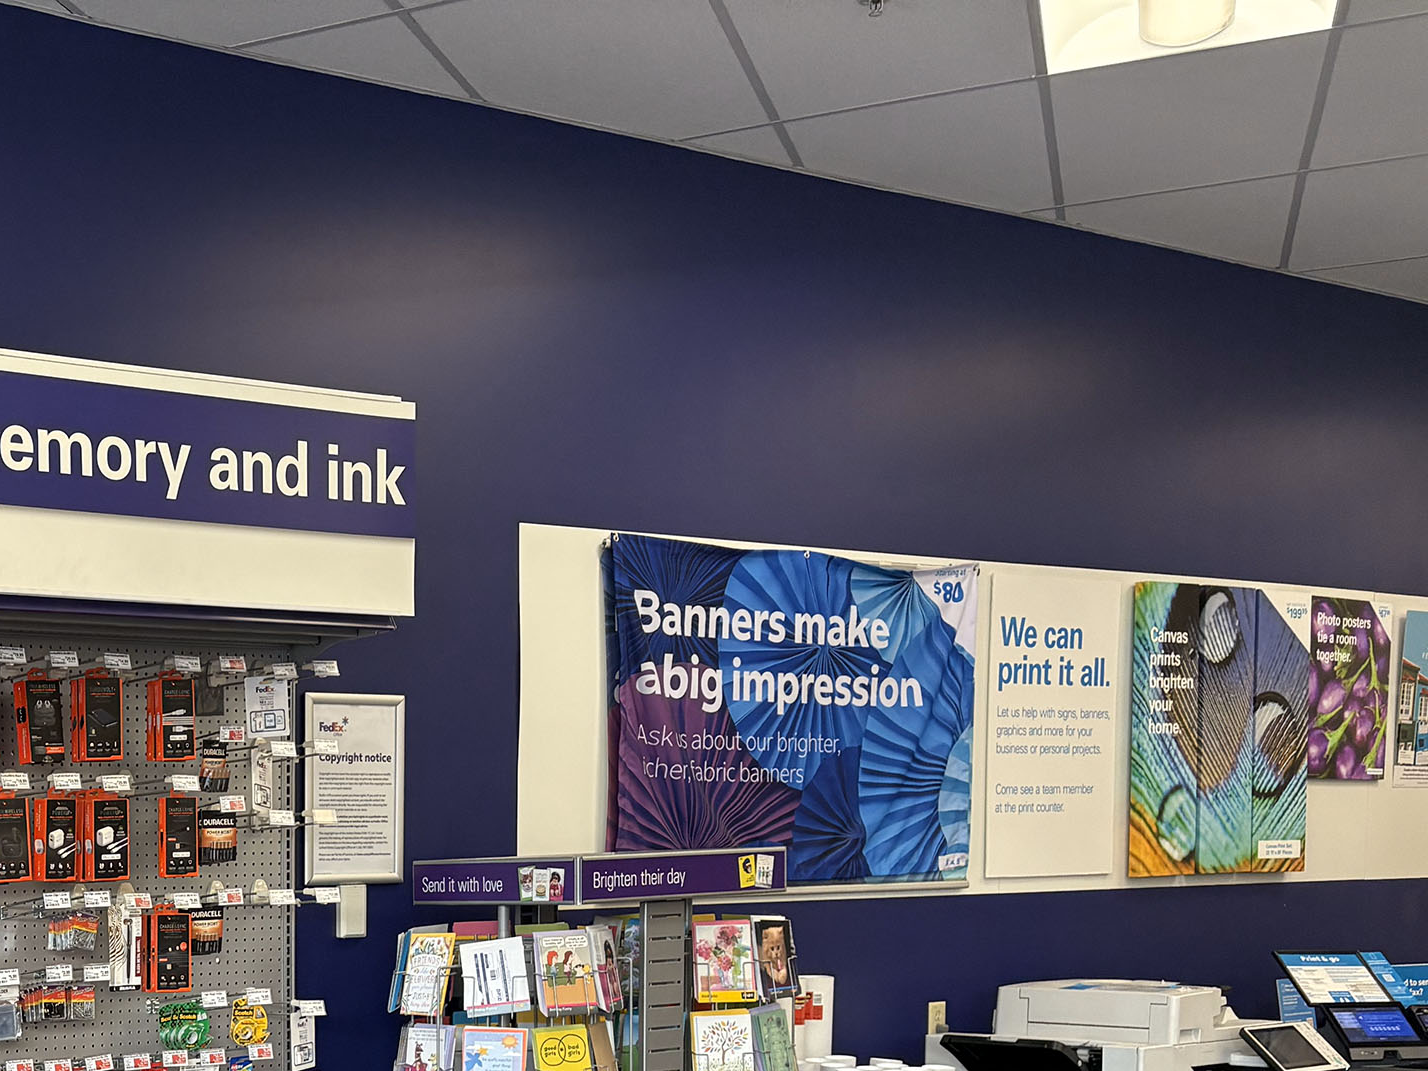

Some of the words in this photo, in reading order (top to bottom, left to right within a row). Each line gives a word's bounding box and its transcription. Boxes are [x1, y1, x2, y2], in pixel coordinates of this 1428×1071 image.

[209, 440, 308, 497] and
[328, 444, 407, 506] ink
[634, 589, 786, 643] Banners
[794, 605, 890, 649] make
[1318, 612, 1341, 626] Photo
[1342, 617, 1371, 630] posters
[1000, 616, 1036, 649] We
[1044, 626, 1083, 650] can
[1150, 627, 1189, 645] Canvas
[1336, 634, 1358, 646] room
[1150, 651, 1180, 670] prints
[1316, 649, 1352, 664] together.
[998, 656, 1051, 692] print
[1058, 656, 1073, 686] it
[1080, 658, 1110, 687] all.
[1149, 672, 1194, 693] brighten
[732, 665, 924, 715] impression
[996, 706, 1009, 720] Let
[1011, 709, 1020, 720] us
[1022, 706, 1039, 722] help
[1040, 707, 1056, 720] with
[1058, 708, 1078, 724] signs,
[1080, 709, 1110, 722] banners,
[1149, 698, 1174, 716] your
[319, 722, 344, 732] FedEx
[996, 724, 1027, 740] graphics
[1028, 726, 1042, 737] and
[1044, 728, 1063, 738] more
[1064, 725, 1075, 738] for
[1076, 727, 1093, 741] your
[1149, 718, 1182, 735] home.
[637, 723, 673, 748] Ask
[676, 731, 688, 750] us
[691, 729, 742, 752] about
[746, 735, 773, 752] our
[777, 731, 842, 757] brighter,
[203, 748, 226, 756] DURACELL
[318, 752, 362, 764] Copyright
[364, 752, 392, 763] notice
[996, 742, 1028, 756] business
[1030, 745, 1038, 755] or
[1039, 742, 1070, 758] personal
[1072, 743, 1101, 758] projects.
[690, 758, 735, 784] fabric
[739, 760, 804, 784] banners
[995, 784, 1018, 796] Come
[1020, 786, 1034, 796] see
[1042, 785, 1058, 796] team
[1060, 784, 1094, 796] member
[995, 802, 1002, 814] at
[1004, 802, 1016, 814] the
[1018, 802, 1037, 816] print
[1038, 803, 1065, 814] counter.
[203, 818, 234, 826] DURACELL
[422, 876, 446, 893] Send
[448, 876, 455, 892] it
[457, 876, 478, 892] with
[482, 877, 503, 892] love
[593, 870, 638, 891] Brighten
[641, 868, 664, 888] their
[666, 868, 686, 888] day
[191, 910, 222, 918] DURACELL
